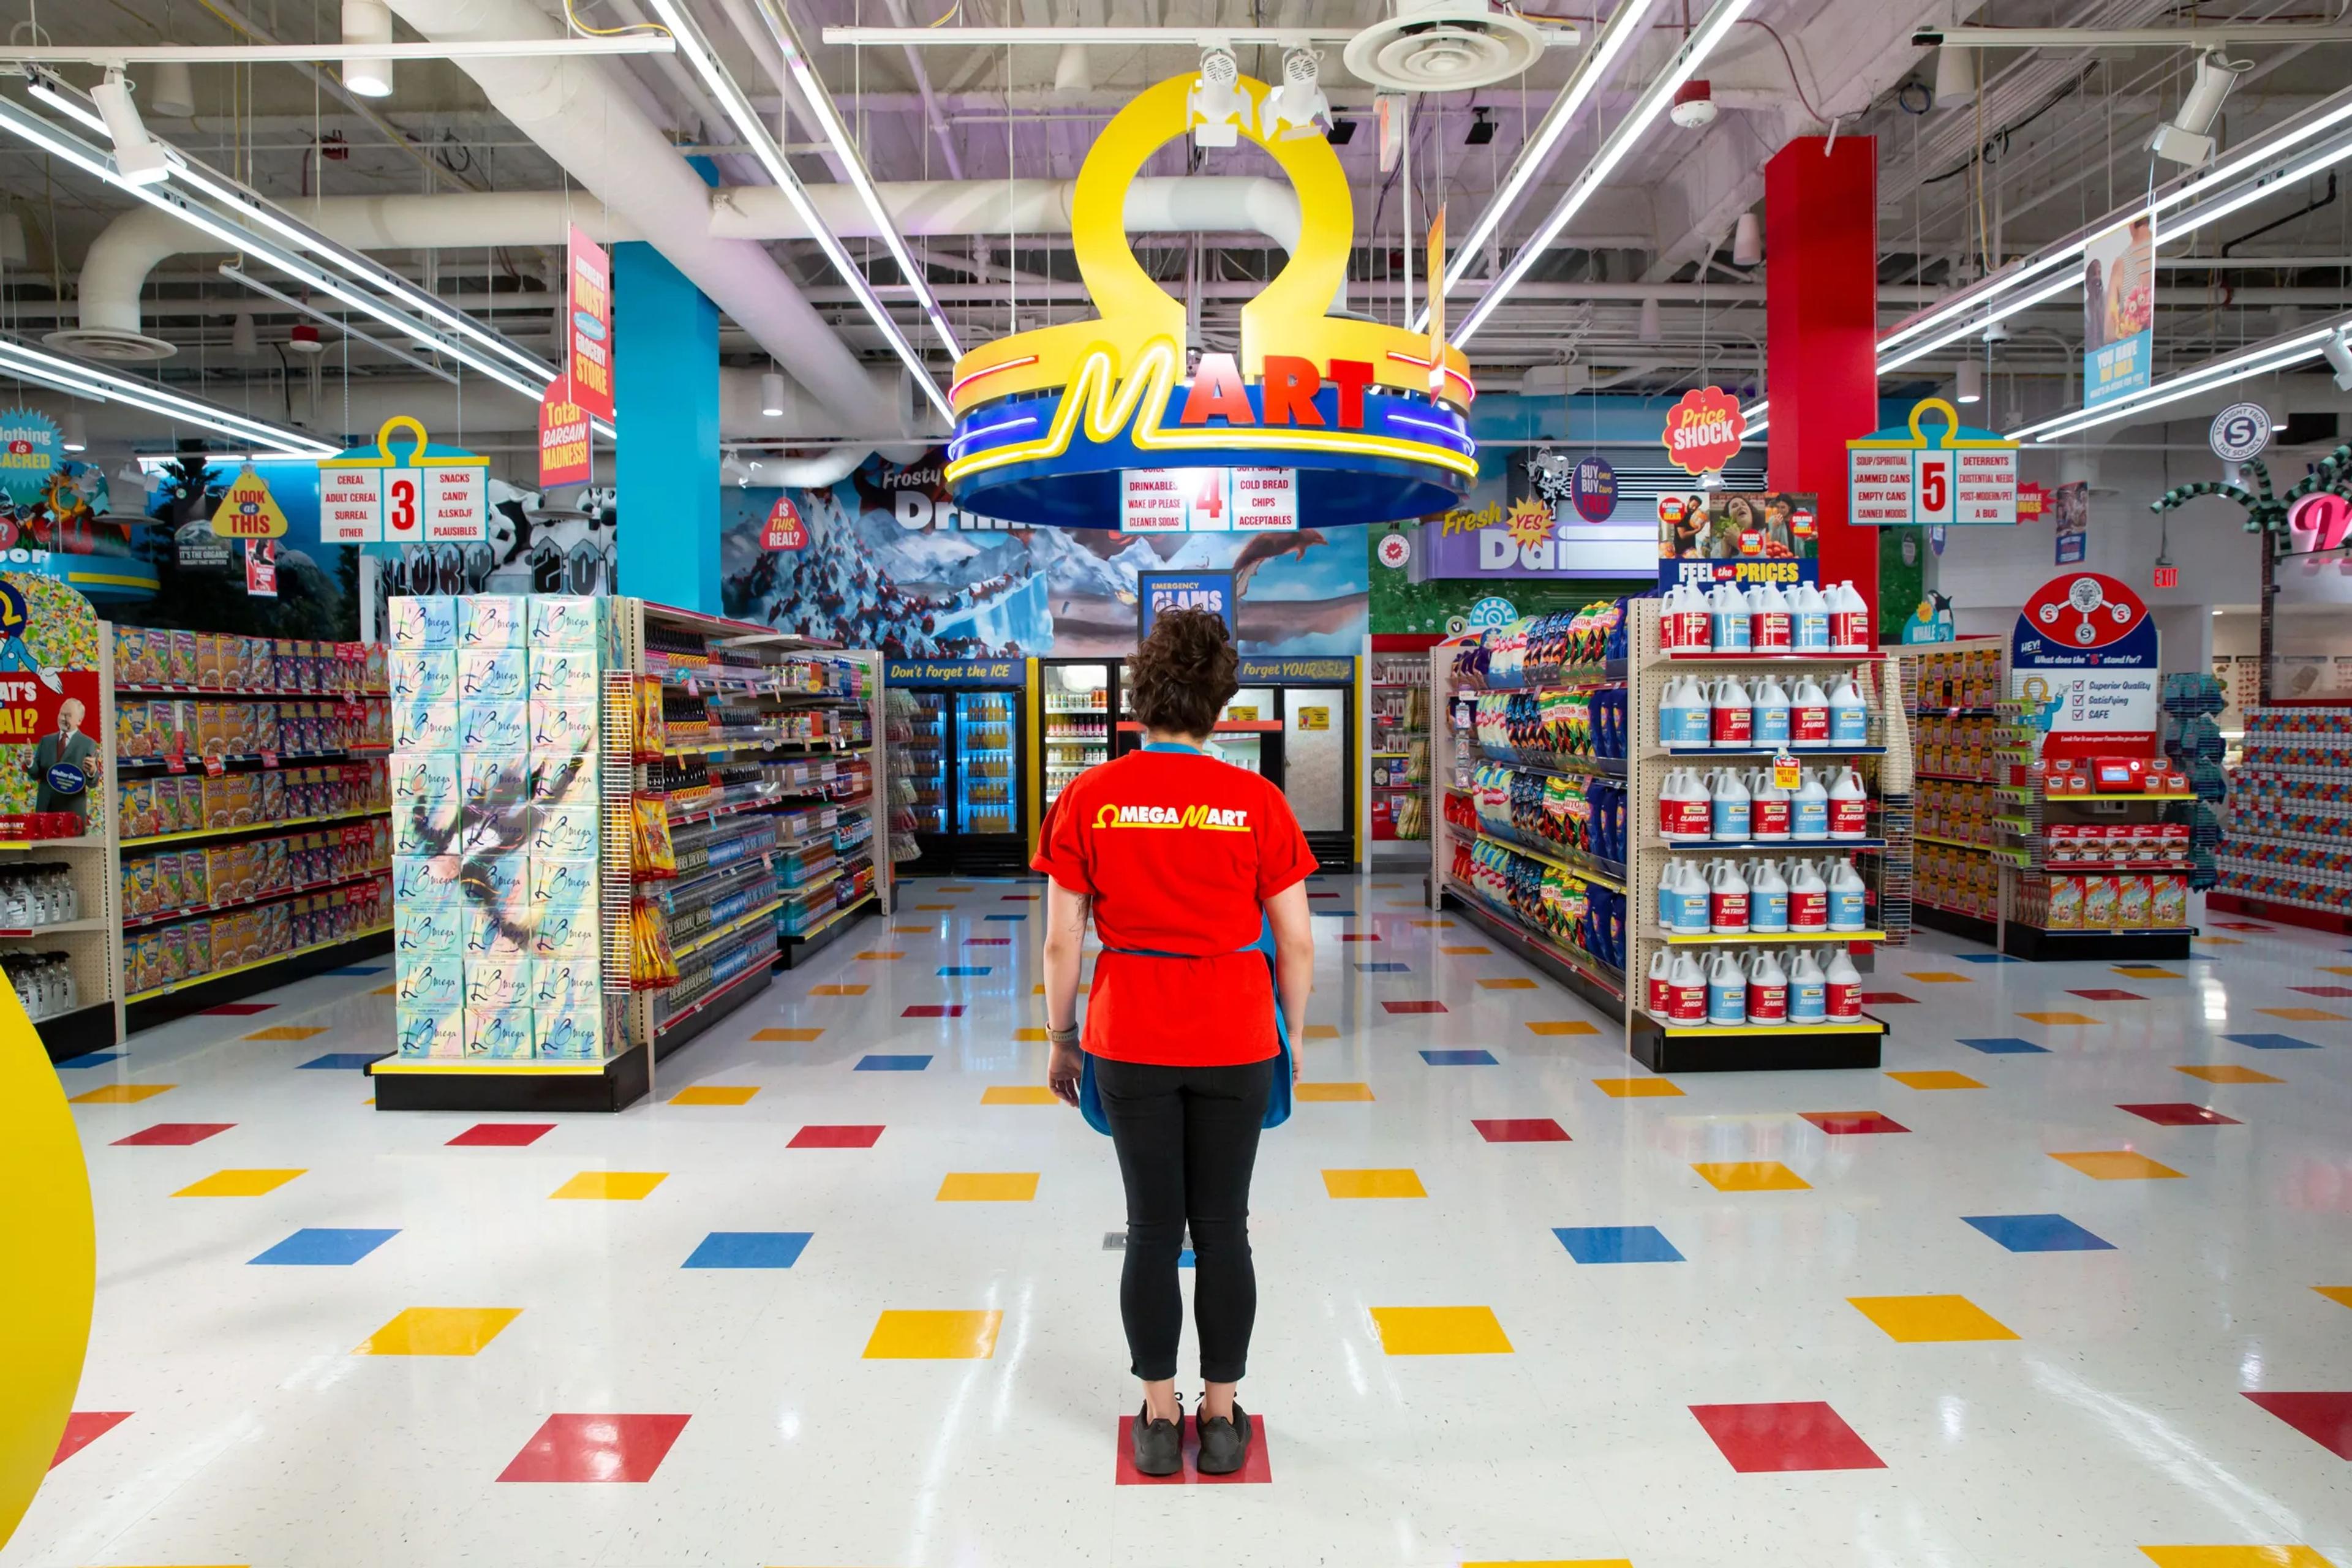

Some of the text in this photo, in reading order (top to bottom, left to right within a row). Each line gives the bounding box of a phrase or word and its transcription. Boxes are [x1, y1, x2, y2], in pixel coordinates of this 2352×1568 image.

[575, 273, 605, 322] MOST
[575, 331, 606, 367] GROCERY
[576, 355, 608, 396] STORE
[1046, 336, 1374, 450] MART
[546, 401, 581, 428] Total
[1681, 405, 1726, 430] Price
[2215, 407, 2265, 436] STRAIGHT FROM
[542, 422, 587, 448] BARGAIN
[1673, 419, 1735, 451] SHOCK
[2229, 420, 2250, 444] S
[15, 441, 28, 454] is
[2217, 436, 2263, 457] THE SOURCE
[0, 453, 50, 469] ACRED
[542, 440, 587, 472] MADNESS!
[1856, 456, 1907, 466] SOUP/SPIRITUAL
[1963, 456, 2009, 466] DETERRENTS
[440, 473, 470, 483] SNACKS
[883, 467, 941, 489] Frosty
[1581, 464, 1599, 479] BUY
[1854, 473, 1910, 483] JAMMED CANS
[1959, 473, 2014, 483] EXISTENTIAL NEEDS
[337, 475, 364, 484] CEREAL
[1129, 481, 1178, 491] DRINKABLES
[1240, 480, 1289, 490] COLD BREAD
[1581, 478, 1599, 493] BUY
[1196, 467, 1223, 518] 4
[1922, 462, 1946, 512] 5
[233, 491, 265, 503] LOOK
[325, 493, 377, 502] ADULT CEREAL
[442, 492, 468, 501] CANDY
[1252, 497, 1276, 507] CHIPS
[1858, 491, 1906, 501] EMPTY CANS
[1960, 491, 2012, 501] POST-MODERN/PET
[244, 504, 255, 514] at
[391, 480, 415, 530] 3
[778, 502, 789, 517] IS
[1128, 499, 1181, 508] WAKE UP PLEASE
[1582, 494, 1610, 514] FREE
[334, 511, 368, 520] SURREAL
[1441, 500, 1502, 538] Fresh
[1858, 508, 1907, 518] CANNED MOODS
[1975, 509, 1997, 518] A BUG
[229, 514, 271, 534] THIS
[771, 517, 795, 532] THIS
[1129, 516, 1179, 527] CLEANER SODAS
[1239, 516, 1292, 526] ACCEPTABLES
[1515, 514, 1543, 530] YES
[339, 528, 363, 537] OTHER
[434, 526, 477, 536] PLAUSIBLES
[769, 531, 801, 546] REAL?
[203, 551, 230, 559] ORGANIC
[1678, 562, 1800, 582] FEEL the PRICES
[2154, 568, 2179, 587] EXIT
[1152, 590, 1223, 613] CLAMS
[2045, 610, 2053, 620] S
[2117, 610, 2125, 620] S
[1912, 625, 1936, 642] WHALE
[2081, 630, 2090, 639] S
[2021, 639, 2041, 653] HEY!
[2034, 655, 2054, 664] What
[2055, 655, 2071, 664] does
[2073, 655, 2086, 664] the
[2103, 655, 2126, 664] stand
[2126, 655, 2142, 664] for?
[891, 664, 1011, 680] Don't forget the ICE
[1243, 662, 1280, 679] forget
[2088, 680, 2151, 692] Superior Quality
[2088, 696, 2128, 706] Satisfying
[2087, 710, 2110, 720] SAFE
[1180, 804, 1249, 827] MART
